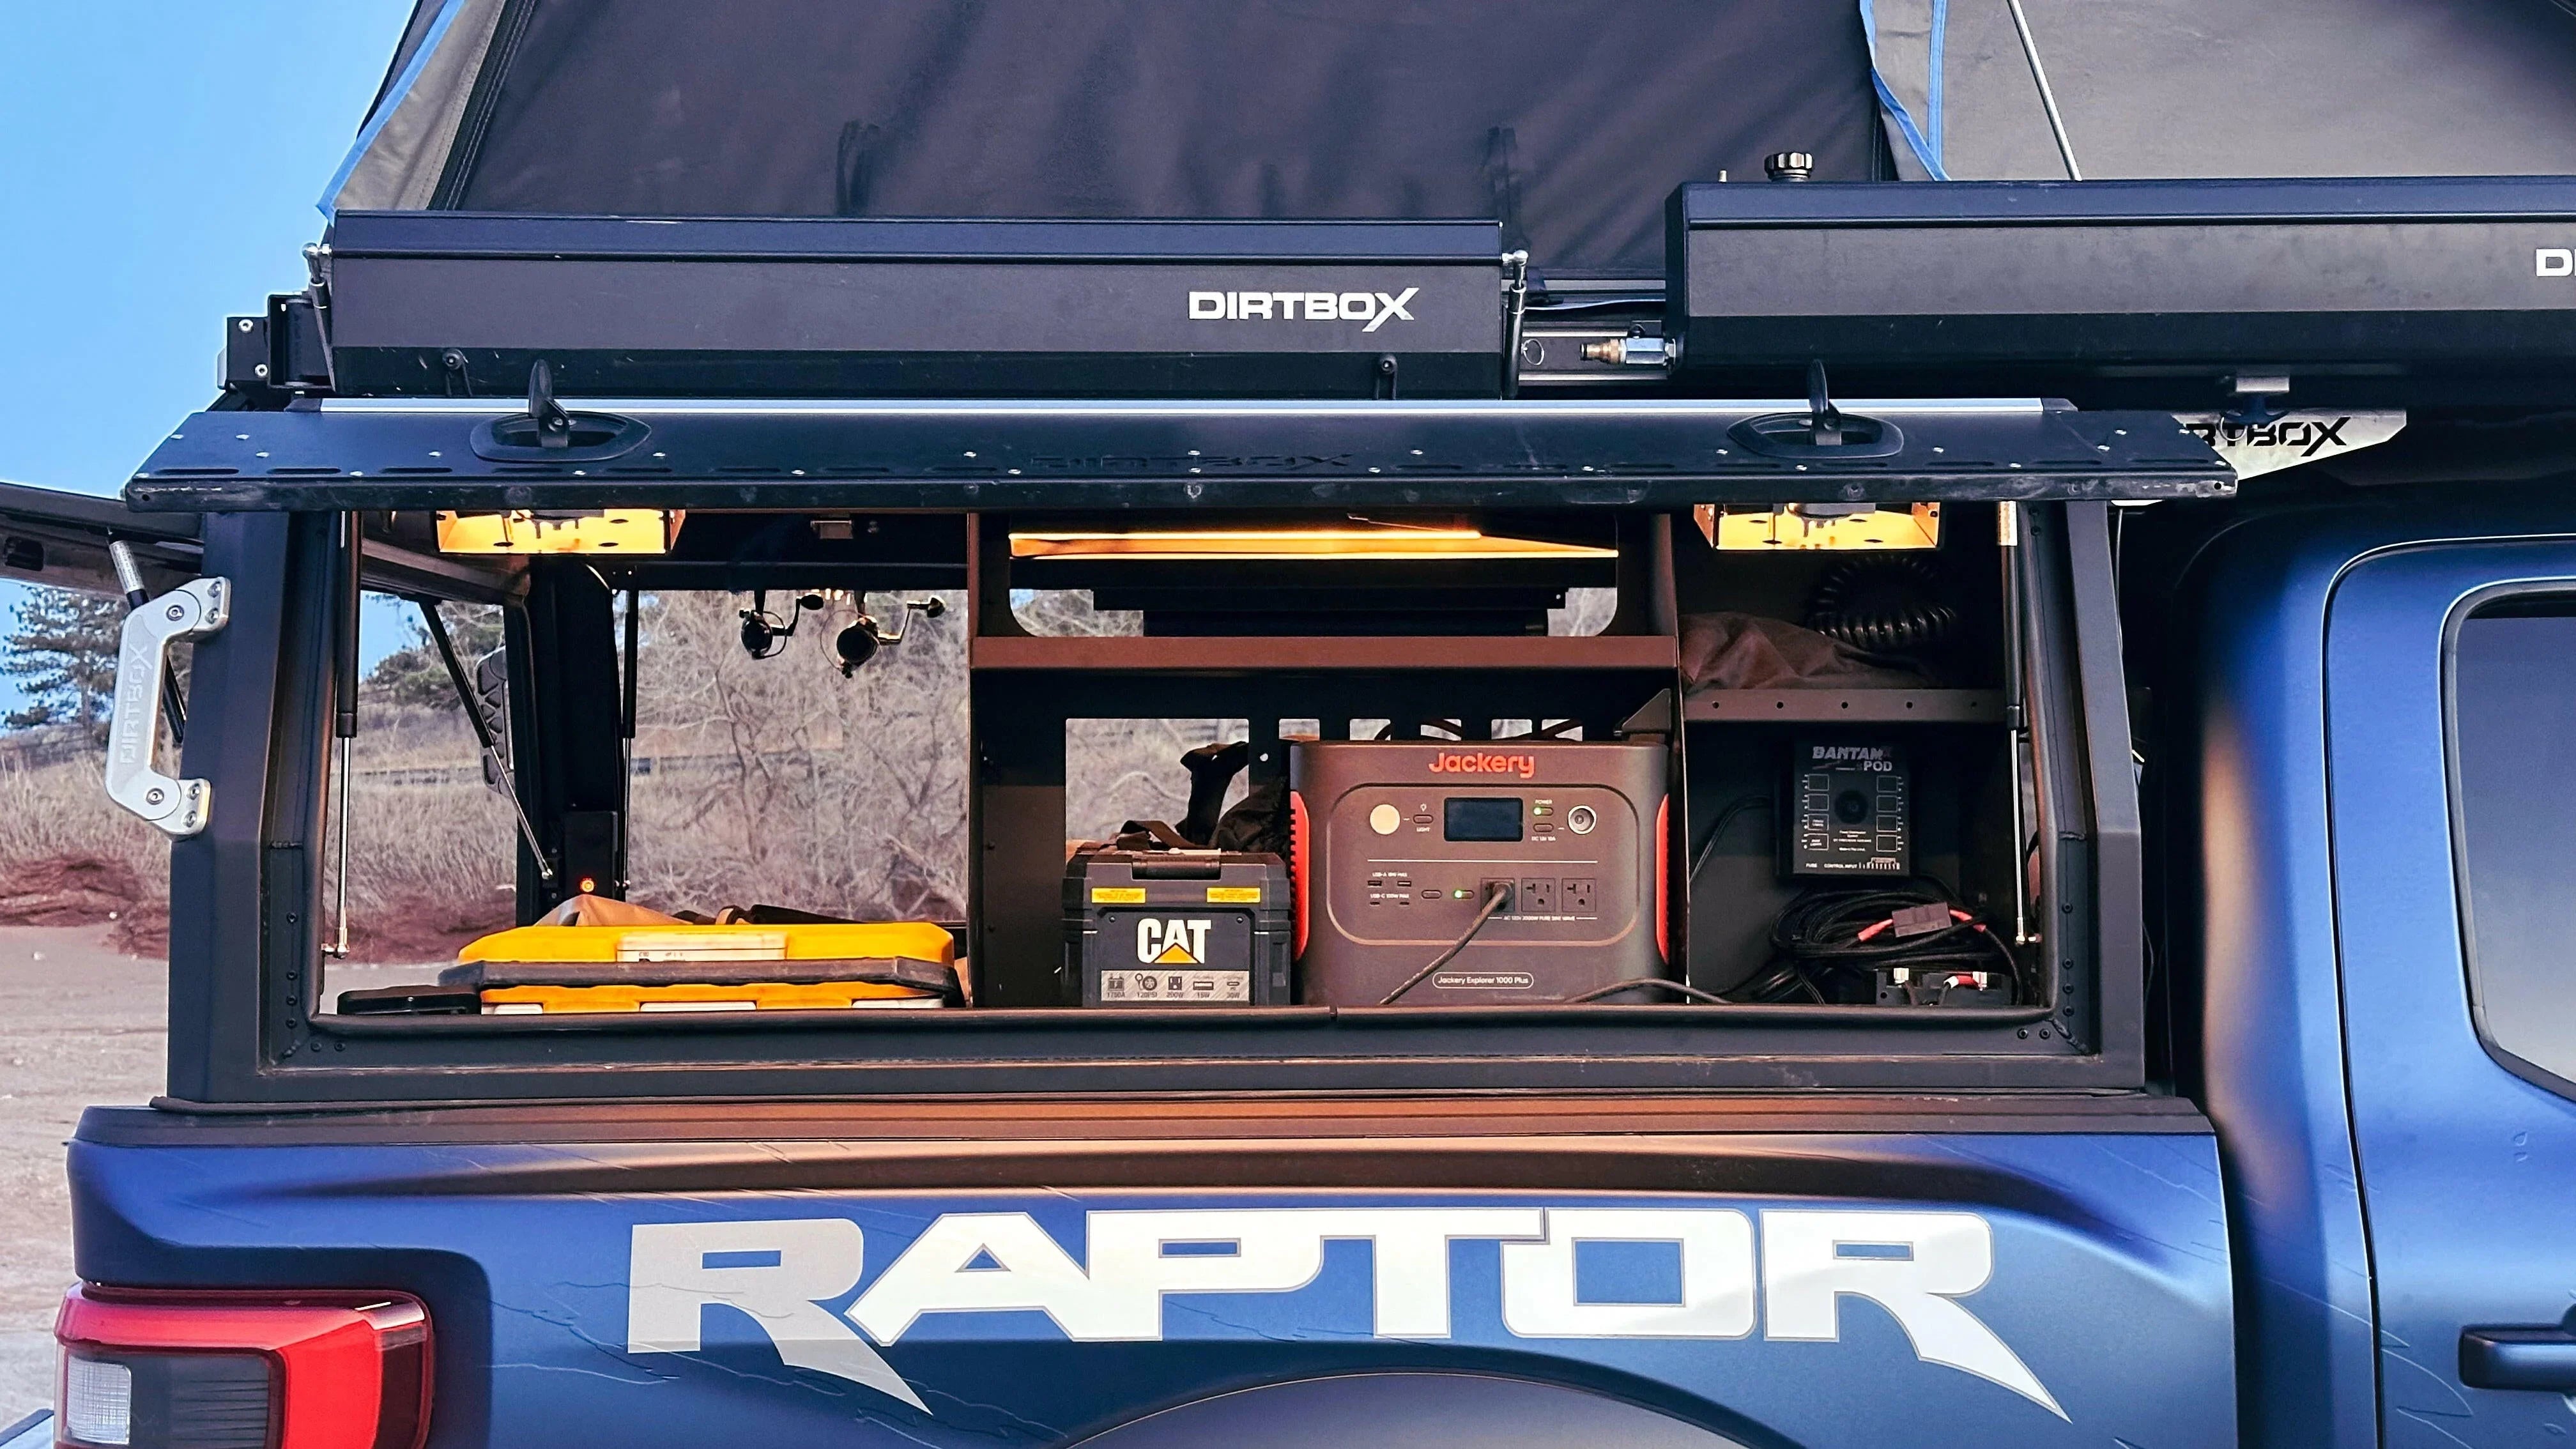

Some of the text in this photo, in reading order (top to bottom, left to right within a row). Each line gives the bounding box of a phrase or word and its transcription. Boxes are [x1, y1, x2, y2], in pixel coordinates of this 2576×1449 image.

[2536, 249, 2576, 277] D
[1188, 287, 1420, 332] DIRTBOX
[1429, 752, 1535, 778] Jackery
[1137, 918, 1212, 964] CAT
[1438, 976, 1466, 985] Jackery
[1466, 976, 1495, 985] Explorer
[628, 1207, 2073, 1424] RAPTOR
